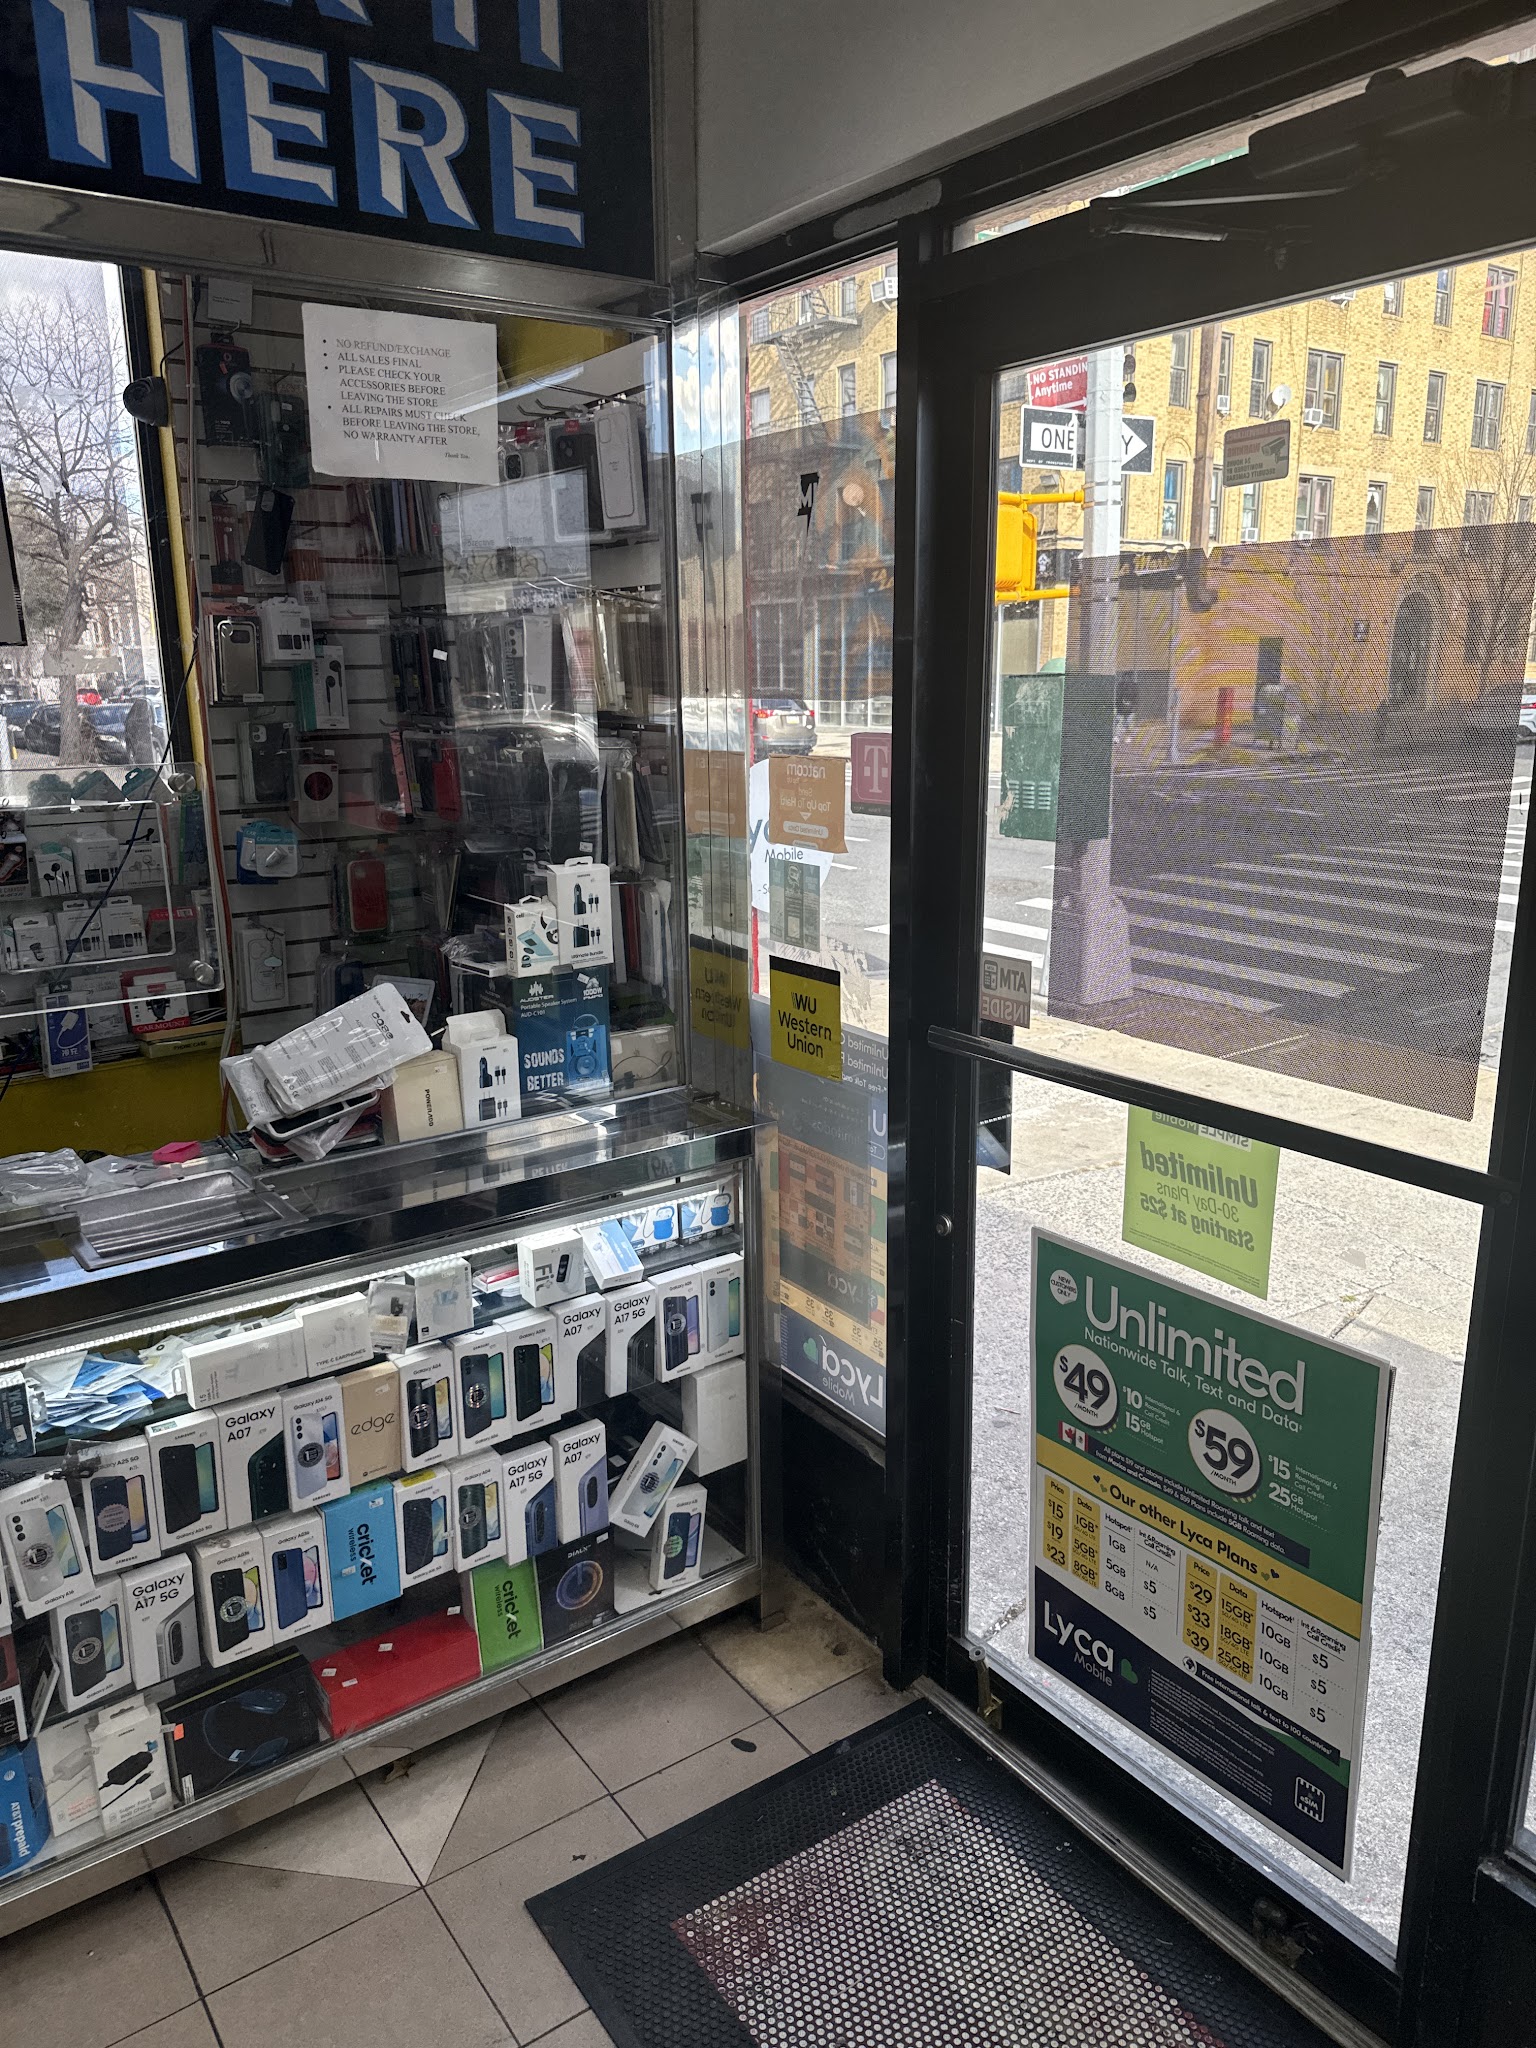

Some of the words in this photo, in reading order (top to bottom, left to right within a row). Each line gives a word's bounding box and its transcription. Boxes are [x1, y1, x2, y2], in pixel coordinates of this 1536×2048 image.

[33, 0, 585, 248] HERE
[337, 339, 351, 348] NO
[354, 341, 451, 357] REFUND/EXCHANGE
[338, 352, 358, 362] ALL
[359, 354, 390, 365] SALES
[393, 358, 421, 368] FINAL
[339, 365, 375, 376] PLEASE
[378, 369, 411, 380] CHECK
[413, 372, 441, 382] YOUR
[1033, 373, 1046, 385] NO
[1048, 362, 1088, 381] STANDIN
[340, 378, 406, 392] ACCESSORIES
[409, 385, 446, 395] BEFORE
[1035, 380, 1073, 398] Anytime
[341, 391, 384, 402] LEAVING
[386, 395, 405, 405] THE
[407, 397, 438, 407] STORE
[342, 405, 362, 413] ALL
[365, 407, 403, 417] REPAIRS
[405, 410, 432, 420] MUST
[434, 412, 467, 422] CHECK
[343, 417, 381, 427] BEFORE
[384, 420, 425, 432] LEAVING
[428, 423, 446, 433] THE
[448, 425, 480, 437] STORE,
[344, 430, 358, 439] NO
[361, 431, 415, 444] WARRANTY
[417, 435, 448, 445] AFTER
[1041, 427, 1074, 450] ONE
[765, 847, 803, 862] Mobile
[541, 1001, 561, 1009] Speaker
[562, 998, 578, 1006] System
[791, 992, 817, 1014] WU
[778, 1009, 832, 1041] Western
[787, 1032, 824, 1059] Union
[524, 1048, 565, 1069] SOUNDS
[526, 1072, 564, 1091] BETTER
[1058, 1274, 1070, 1285] NEW
[614, 1295, 650, 1312] Galaxy
[1057, 1287, 1070, 1299] ONLY
[563, 1307, 602, 1325] Galaxy
[614, 1311, 629, 1325] A17
[632, 1308, 646, 1319] 5G
[563, 1324, 582, 1338] A07
[335, 1348, 366, 1364] EARPHONES
[1085, 1274, 1306, 1417] Unlimited
[413, 1366, 431, 1375] Galaxy
[1084, 1326, 1156, 1371] Nationwide
[1159, 1358, 1191, 1388] Talk,
[1194, 1374, 1222, 1400] Text
[1227, 1388, 1256, 1415] and
[1059, 1352, 1110, 1416] $49
[1122, 1384, 1142, 1411] $10
[1144, 1393, 1175, 1414] International
[225, 1407, 276, 1428] Galaxy
[1074, 1401, 1098, 1419] /MONTH
[1144, 1401, 1166, 1418] Roaming
[351, 1412, 395, 1435] edge
[1125, 1410, 1140, 1434] 15
[1140, 1418, 1151, 1431] GB
[227, 1427, 252, 1443] A07
[563, 1433, 601, 1453] Galaxy
[1140, 1427, 1163, 1447] Hotspot
[117, 1457, 129, 1465] A25
[564, 1451, 582, 1466] A07
[1193, 1416, 1253, 1486] $59
[507, 1455, 548, 1477] Galaxy
[1267, 1453, 1291, 1481] $15
[1294, 1464, 1332, 1488] International
[464, 1472, 482, 1482] Galaxy
[509, 1476, 526, 1490] A17
[528, 1470, 543, 1483] 5G
[1050, 1480, 1064, 1495] Price
[1210, 1468, 1236, 1488] /MONTH
[1294, 1472, 1320, 1492] Roaming
[1268, 1480, 1290, 1508] 25
[1290, 1491, 1303, 1506] GB
[1294, 1479, 1306, 1493] Call
[1307, 1486, 1324, 1501] Credit
[1048, 1497, 1063, 1520] $15
[1077, 1497, 1092, 1513] Data
[1290, 1501, 1317, 1523] Hotspot
[1047, 1519, 1063, 1542] $19
[1109, 1482, 1135, 1509] Our
[1138, 1498, 1175, 1531] other
[1179, 1520, 1212, 1552] Lyca
[1216, 1539, 1257, 1576] Plans
[347, 1528, 357, 1562] wireless
[357, 1523, 377, 1586] cricket
[1046, 1542, 1065, 1567] $23
[1108, 1535, 1125, 1555] 1GB
[1106, 1556, 1126, 1578] 5GB
[1145, 1559, 1158, 1572] N/A
[1193, 1561, 1210, 1578] Price
[132, 1573, 185, 1597] Galaxy
[1104, 1579, 1125, 1602] 8GB
[1143, 1576, 1156, 1596] $5
[1189, 1578, 1213, 1607] $29
[1228, 1581, 1247, 1600] Data
[44, 1594, 65, 1605] Galaxy
[135, 1594, 158, 1612] A17
[160, 1588, 179, 1603] 5G
[502, 1580, 522, 1640] cricket
[1143, 1601, 1156, 1622] $5
[1187, 1602, 1210, 1630] $33
[1044, 1599, 1113, 1680] Lyca
[1186, 1626, 1209, 1654] $39
[1260, 1621, 1291, 1650] 10GB
[1073, 1649, 1112, 1688] Mobile
[1259, 1647, 1289, 1676] 10GB
[1311, 1648, 1329, 1671] $5
[1201, 1668, 1214, 1684] Free
[1214, 1676, 1250, 1706] international
[1258, 1672, 1288, 1702] 10GB
[1310, 1674, 1327, 1697] $5
[1309, 1702, 1326, 1725] $5
[13, 1819, 31, 1858] prepaid
